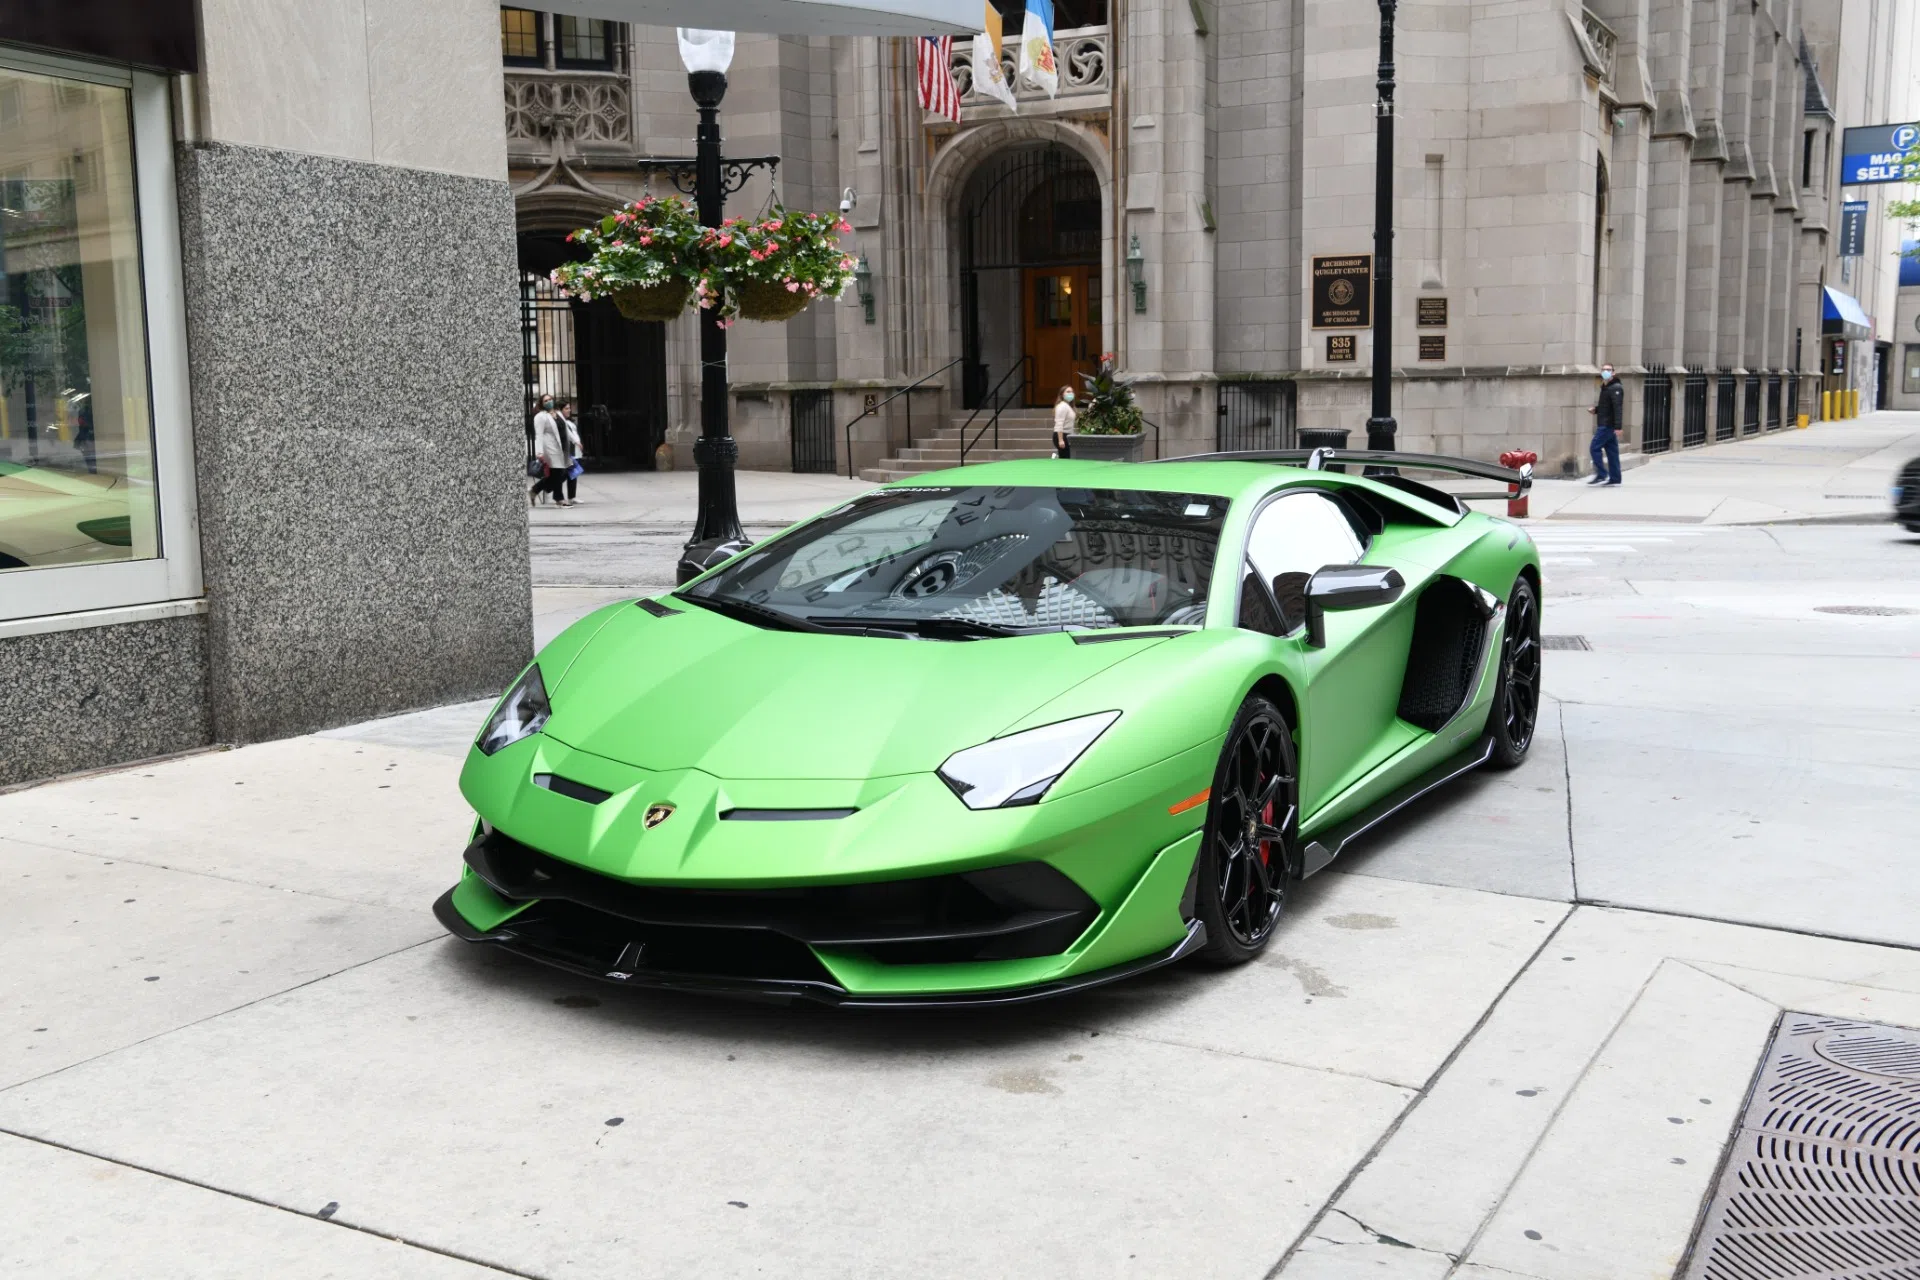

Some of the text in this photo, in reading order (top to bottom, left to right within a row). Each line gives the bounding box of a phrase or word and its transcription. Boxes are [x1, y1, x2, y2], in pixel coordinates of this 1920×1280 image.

[1870, 153, 1902, 165] MAG
[1856, 166, 1900, 180] SELF
[1849, 213, 1857, 253] PARKING
[1315, 269, 1342, 277] QUIGLEY
[1332, 337, 1350, 348] 835
